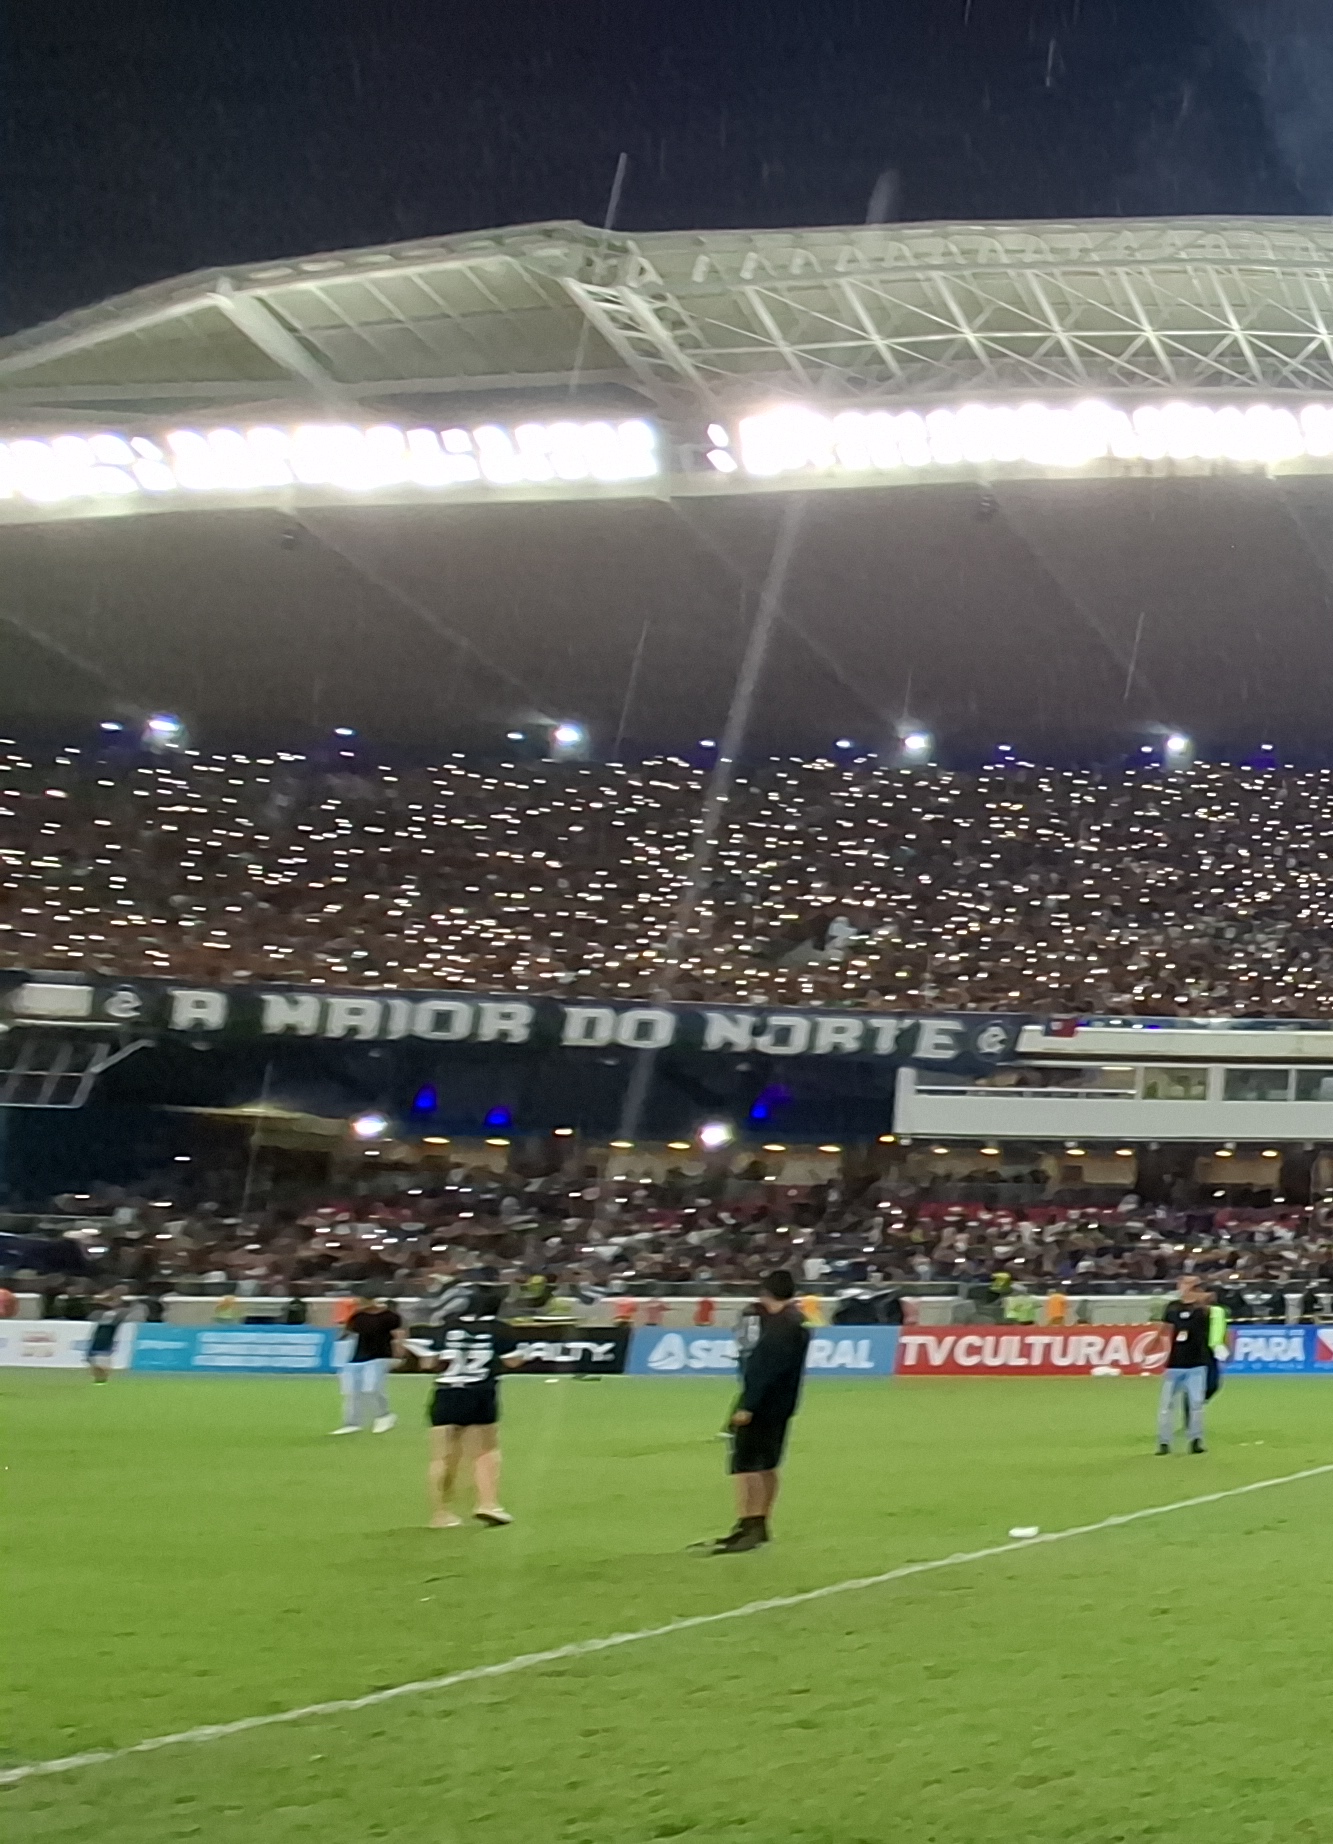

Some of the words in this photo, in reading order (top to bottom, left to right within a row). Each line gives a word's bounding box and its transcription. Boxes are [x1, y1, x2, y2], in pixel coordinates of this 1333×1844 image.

[169, 990, 229, 1031] A
[260, 994, 535, 1043] MAIOR
[560, 1006, 677, 1049] DO
[702, 1011, 967, 1059] NORTE
